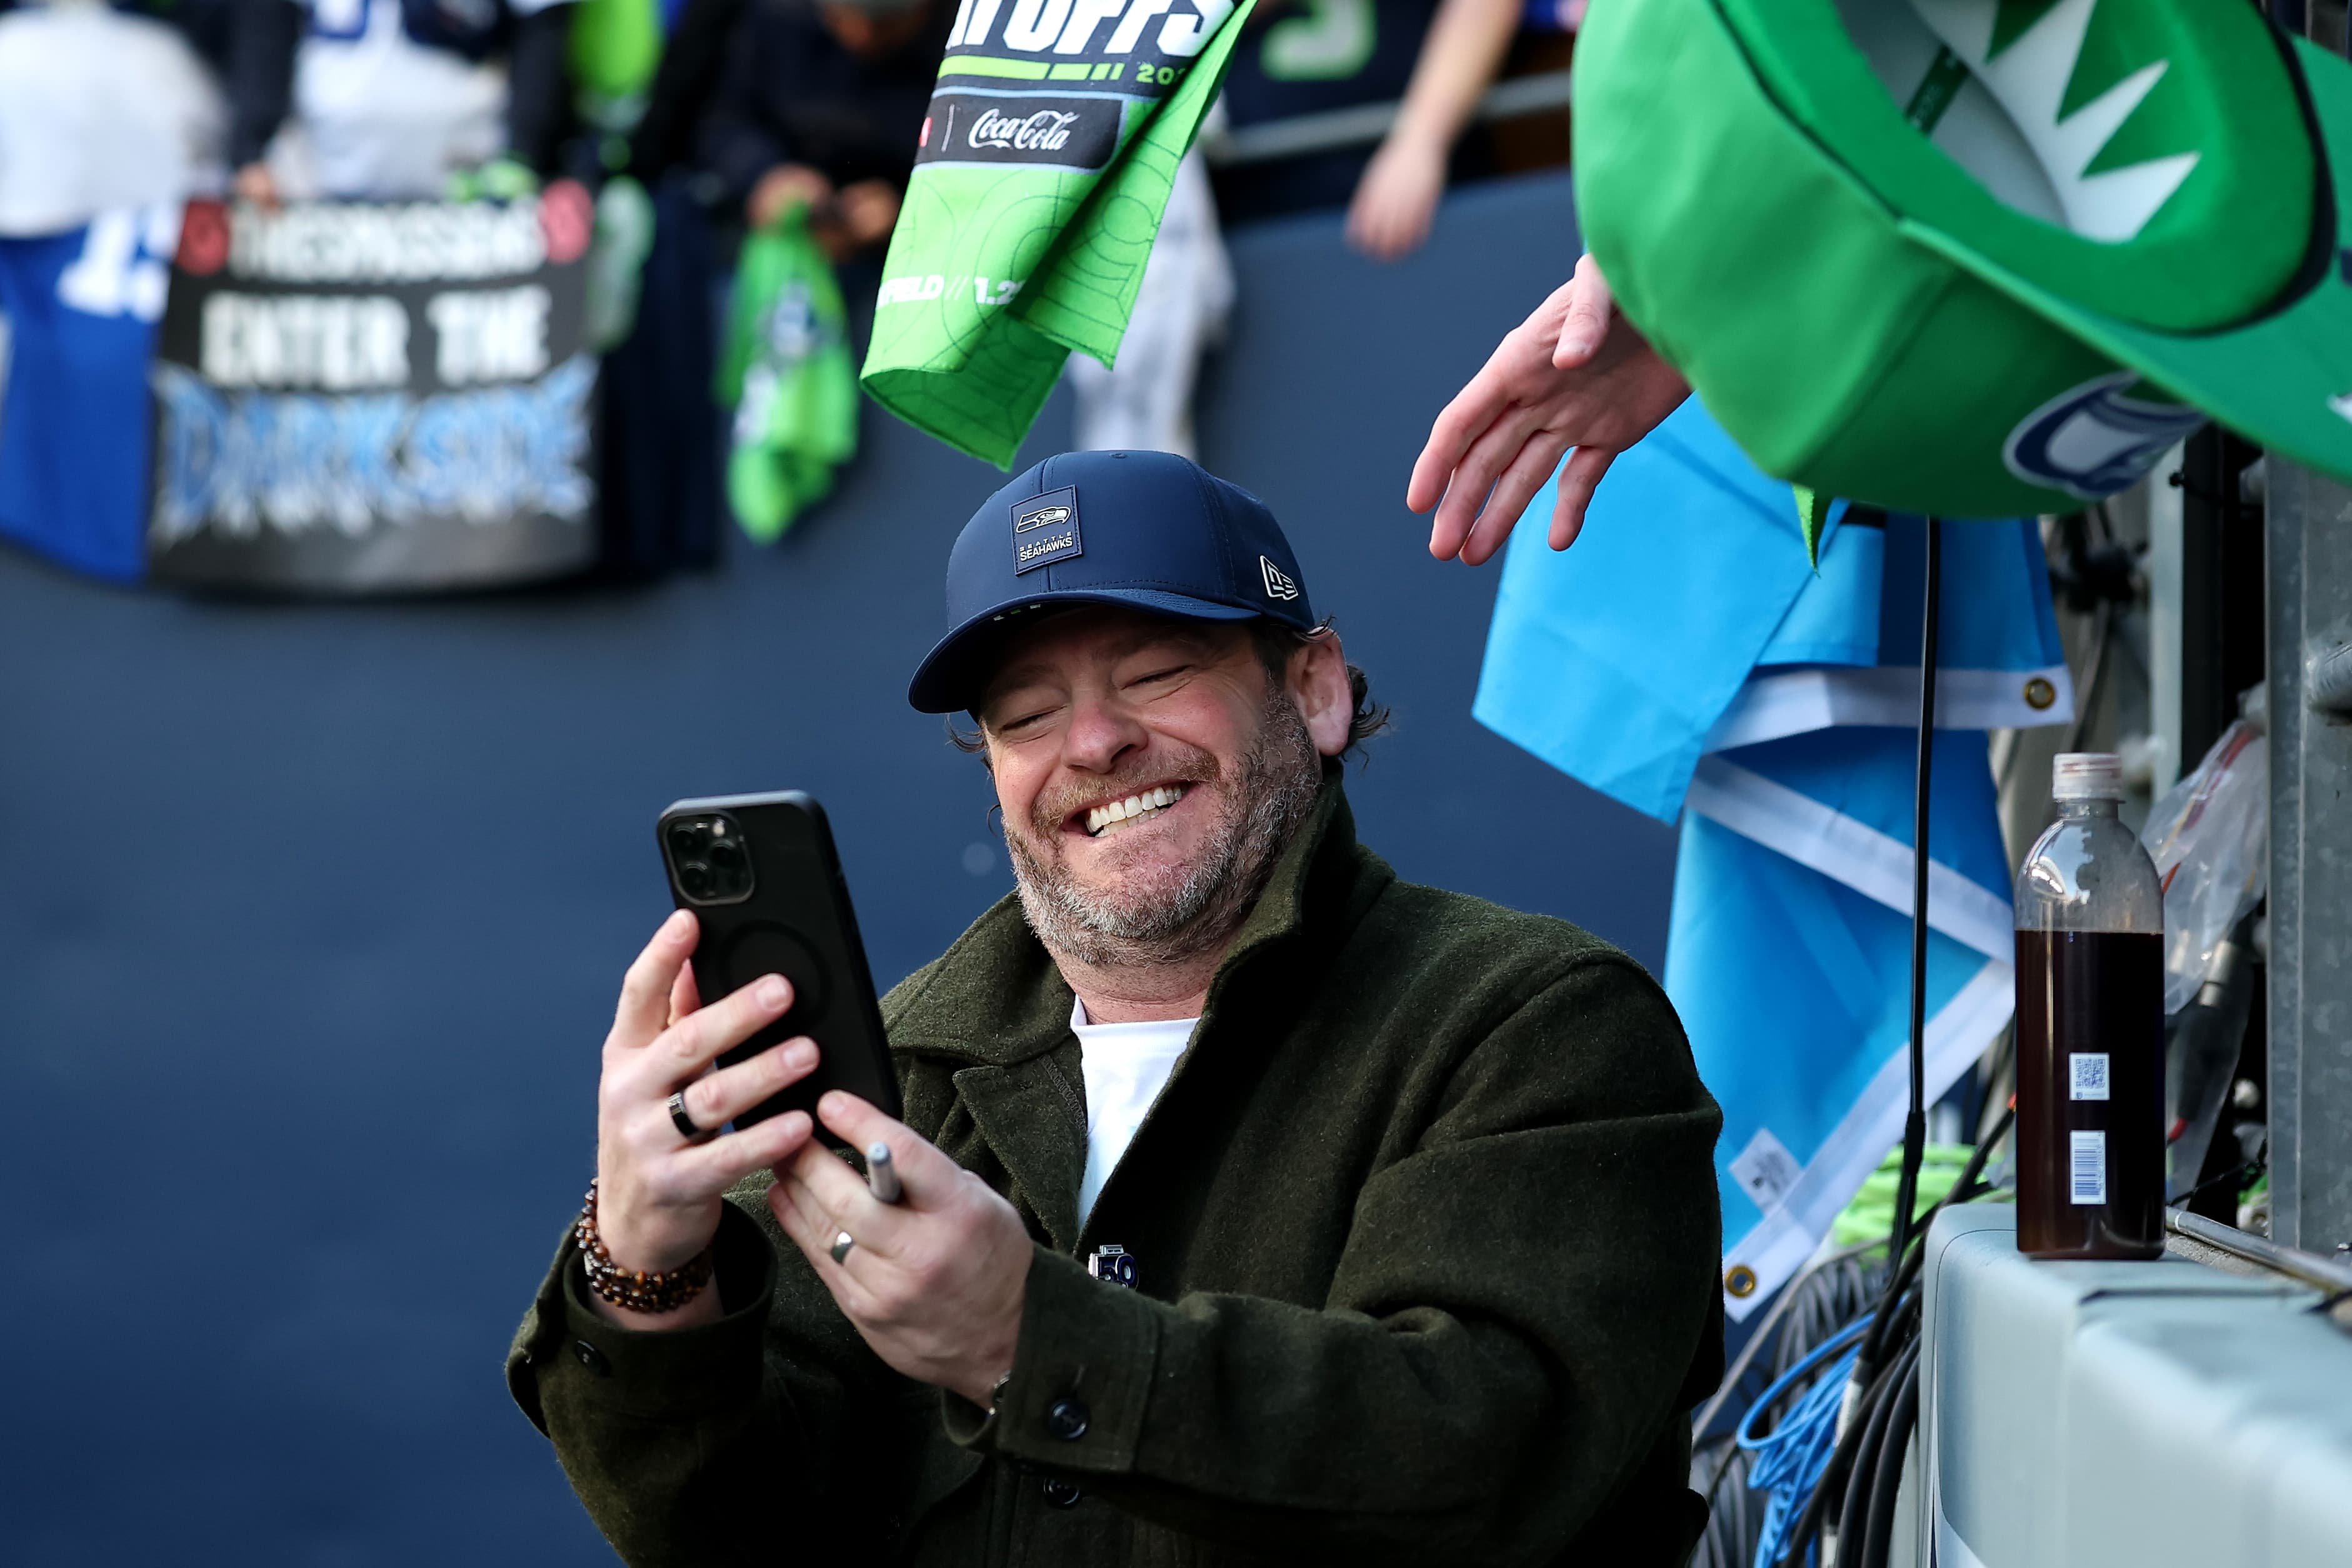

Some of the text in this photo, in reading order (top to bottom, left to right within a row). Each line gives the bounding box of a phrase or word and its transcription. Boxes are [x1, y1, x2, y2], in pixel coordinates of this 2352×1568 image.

[1136, 62, 1186, 85] 20
[968, 108, 1080, 150] Coca-Cola
[974, 277, 1026, 305] 1.2
[201, 284, 553, 389] ENTER THE
[1019, 531, 1071, 552] SEATTLE
[1019, 536, 1073, 561] SEAHAWKS
